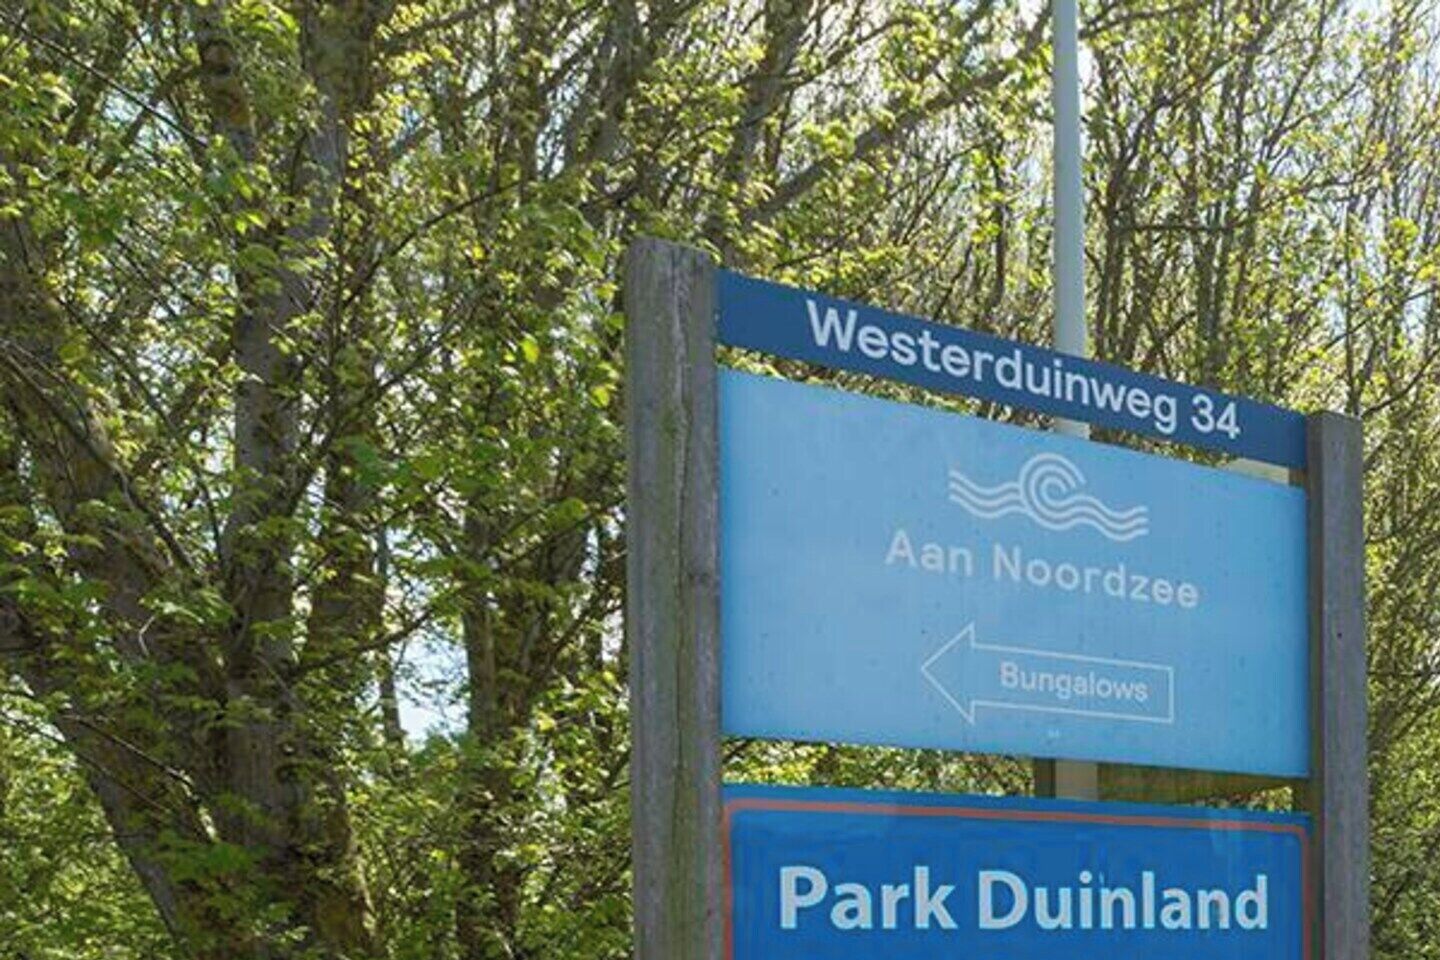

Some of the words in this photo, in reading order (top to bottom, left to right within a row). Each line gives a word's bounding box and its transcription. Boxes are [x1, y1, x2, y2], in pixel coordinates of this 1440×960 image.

[805, 299, 1179, 436] Westerduinweg
[1190, 393, 1241, 440] 34
[885, 530, 974, 577] Aan
[993, 544, 1200, 609] Noordzee
[1000, 661, 1148, 703] Bungalows
[778, 865, 959, 931] Park
[977, 869, 1269, 931] Duinland
